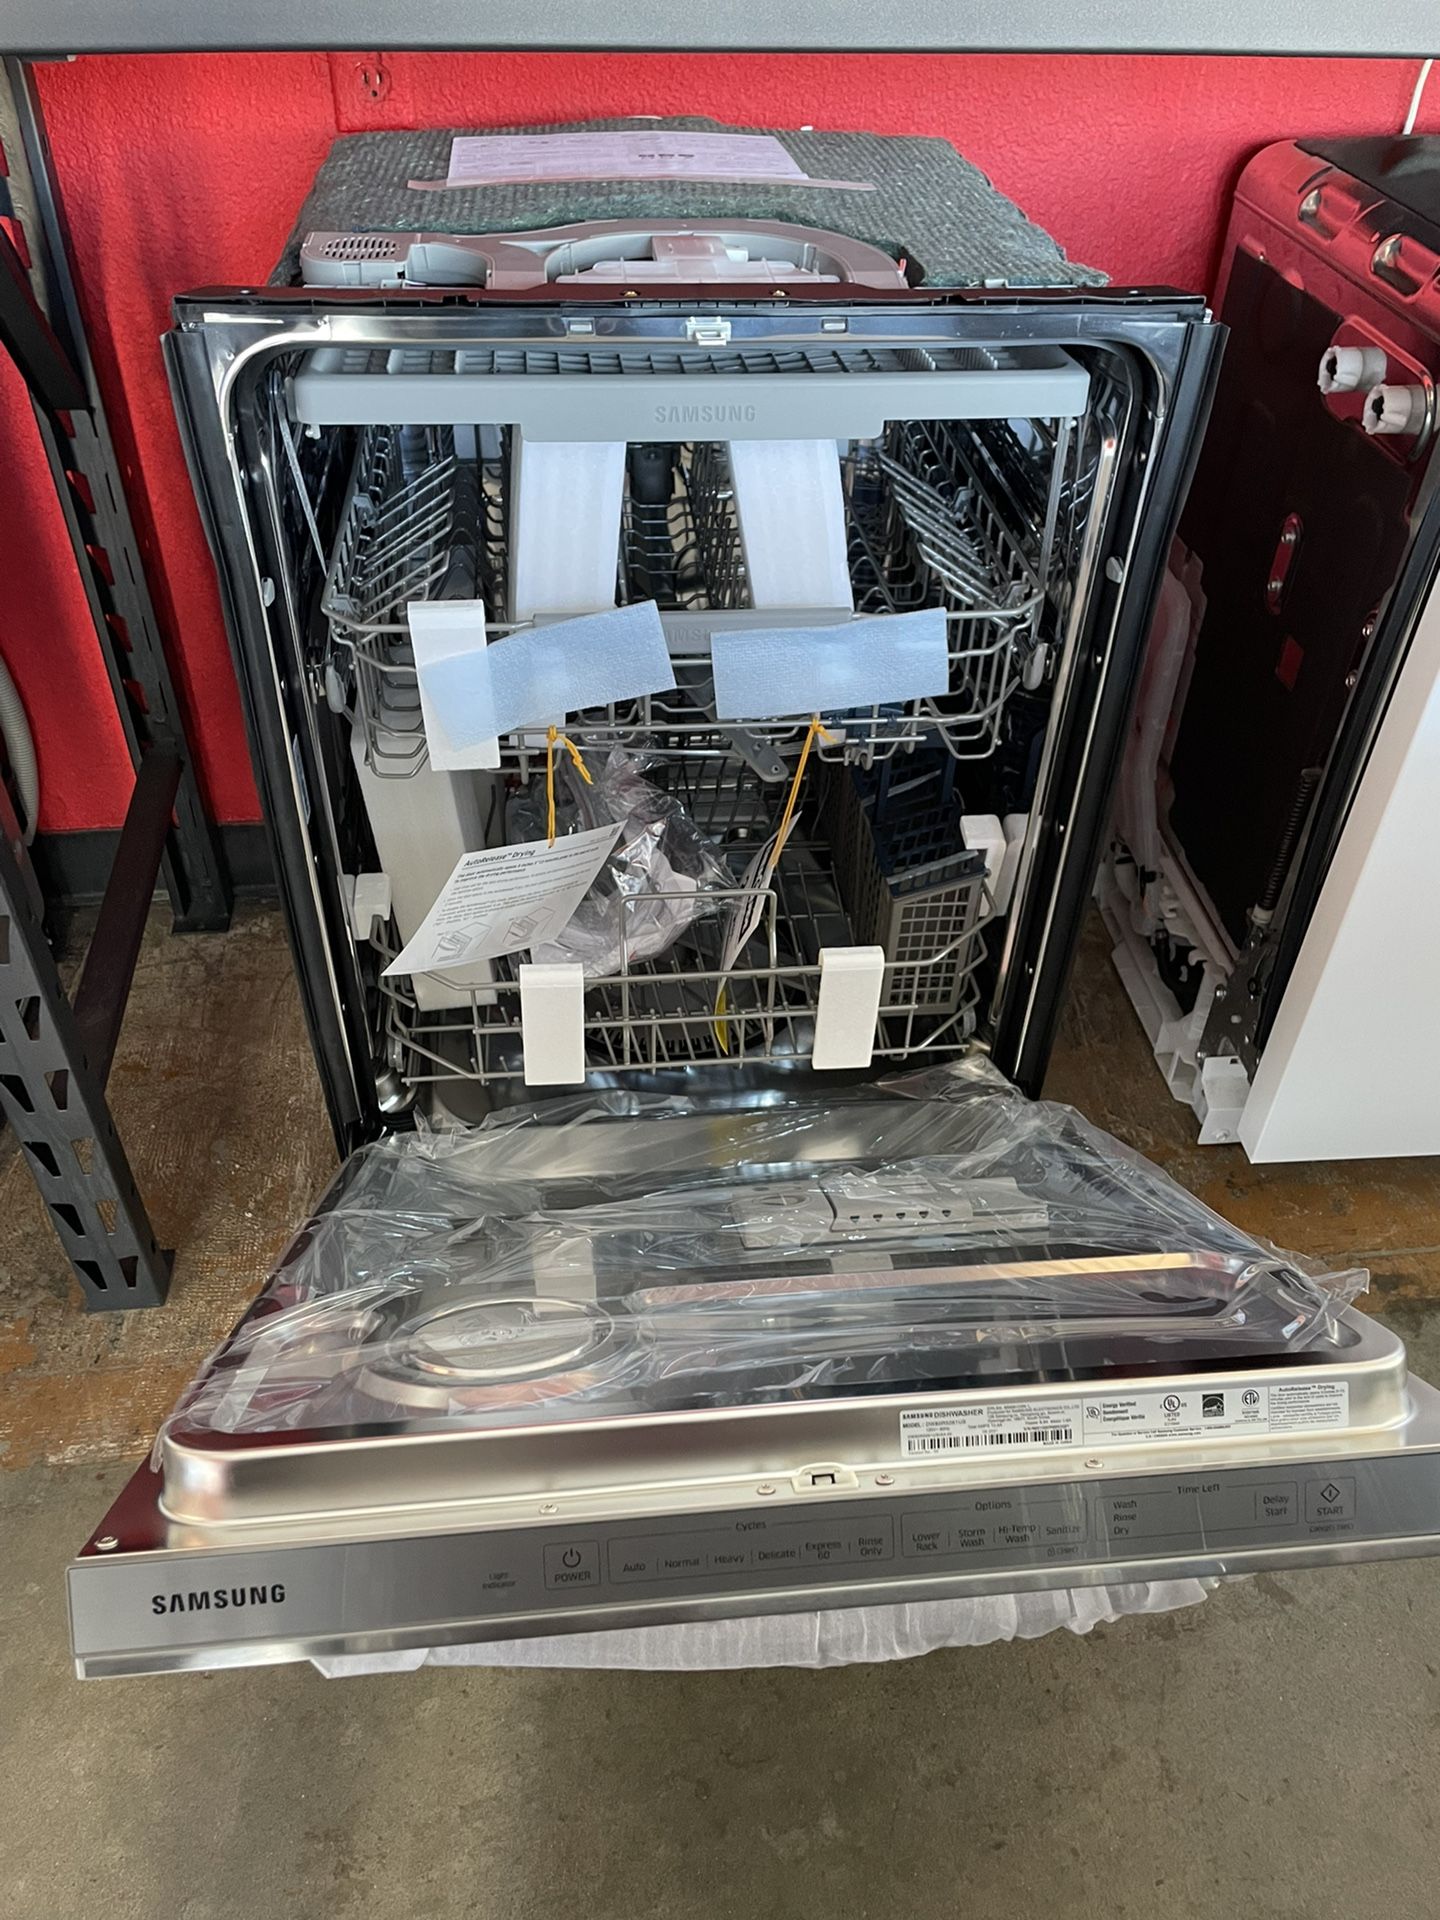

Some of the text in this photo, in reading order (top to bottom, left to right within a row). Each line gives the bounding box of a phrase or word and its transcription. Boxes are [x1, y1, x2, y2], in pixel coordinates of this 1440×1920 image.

[655, 405, 756, 424] SAMSUNG
[512, 849, 536, 859] Drying
[933, 1408, 984, 1418] DISHWASHER
[1177, 1483, 1220, 1494] Time Left
[1113, 1500, 1137, 1509] Wash
[1263, 1495, 1289, 1505] Delay
[975, 1501, 1012, 1511] Options
[1316, 1506, 1344, 1516] START
[1265, 1507, 1288, 1517] Start
[1113, 1513, 1137, 1522] Rinse
[735, 1521, 767, 1532] Cycles
[998, 1524, 1036, 1534] Hi-Temp
[1113, 1526, 1129, 1535] Dry
[912, 1532, 940, 1542] Lower
[958, 1528, 986, 1538] Storm
[858, 1537, 883, 1546] Rinse
[960, 1538, 984, 1548] Wash
[1005, 1535, 1030, 1544] Wash
[805, 1541, 842, 1552] Express
[916, 1542, 938, 1551] Rack
[758, 1550, 796, 1560] Delicate
[817, 1551, 830, 1560] 60
[860, 1547, 882, 1557] Only
[664, 1558, 700, 1568] Normal
[714, 1554, 745, 1564] Heavy
[623, 1562, 646, 1572] Auto
[554, 1570, 591, 1583] POWER
[152, 1584, 285, 1615] SAMSUNG
